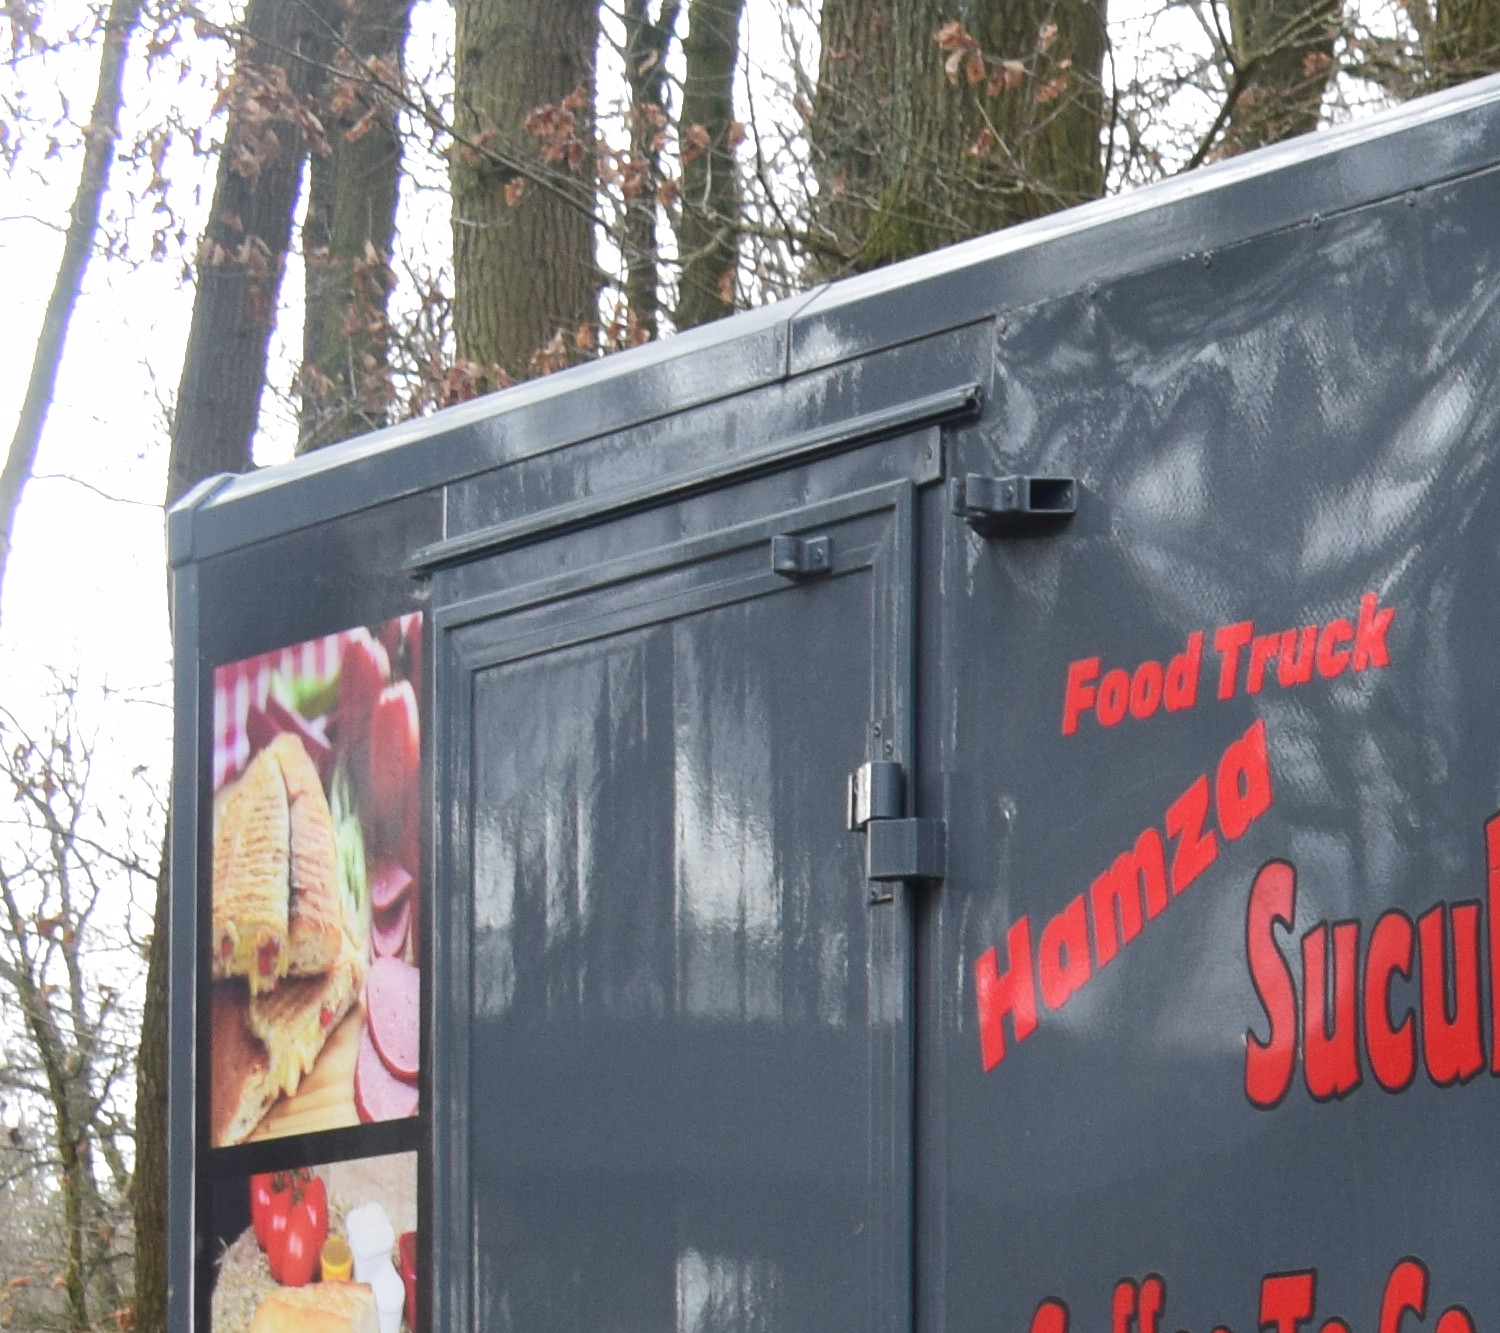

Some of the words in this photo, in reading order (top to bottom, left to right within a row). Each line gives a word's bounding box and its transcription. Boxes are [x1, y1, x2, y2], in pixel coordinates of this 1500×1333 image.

[1061, 656, 1203, 736] Food
[1214, 592, 1396, 702] Truck
[974, 719, 1274, 1073] Hamza
